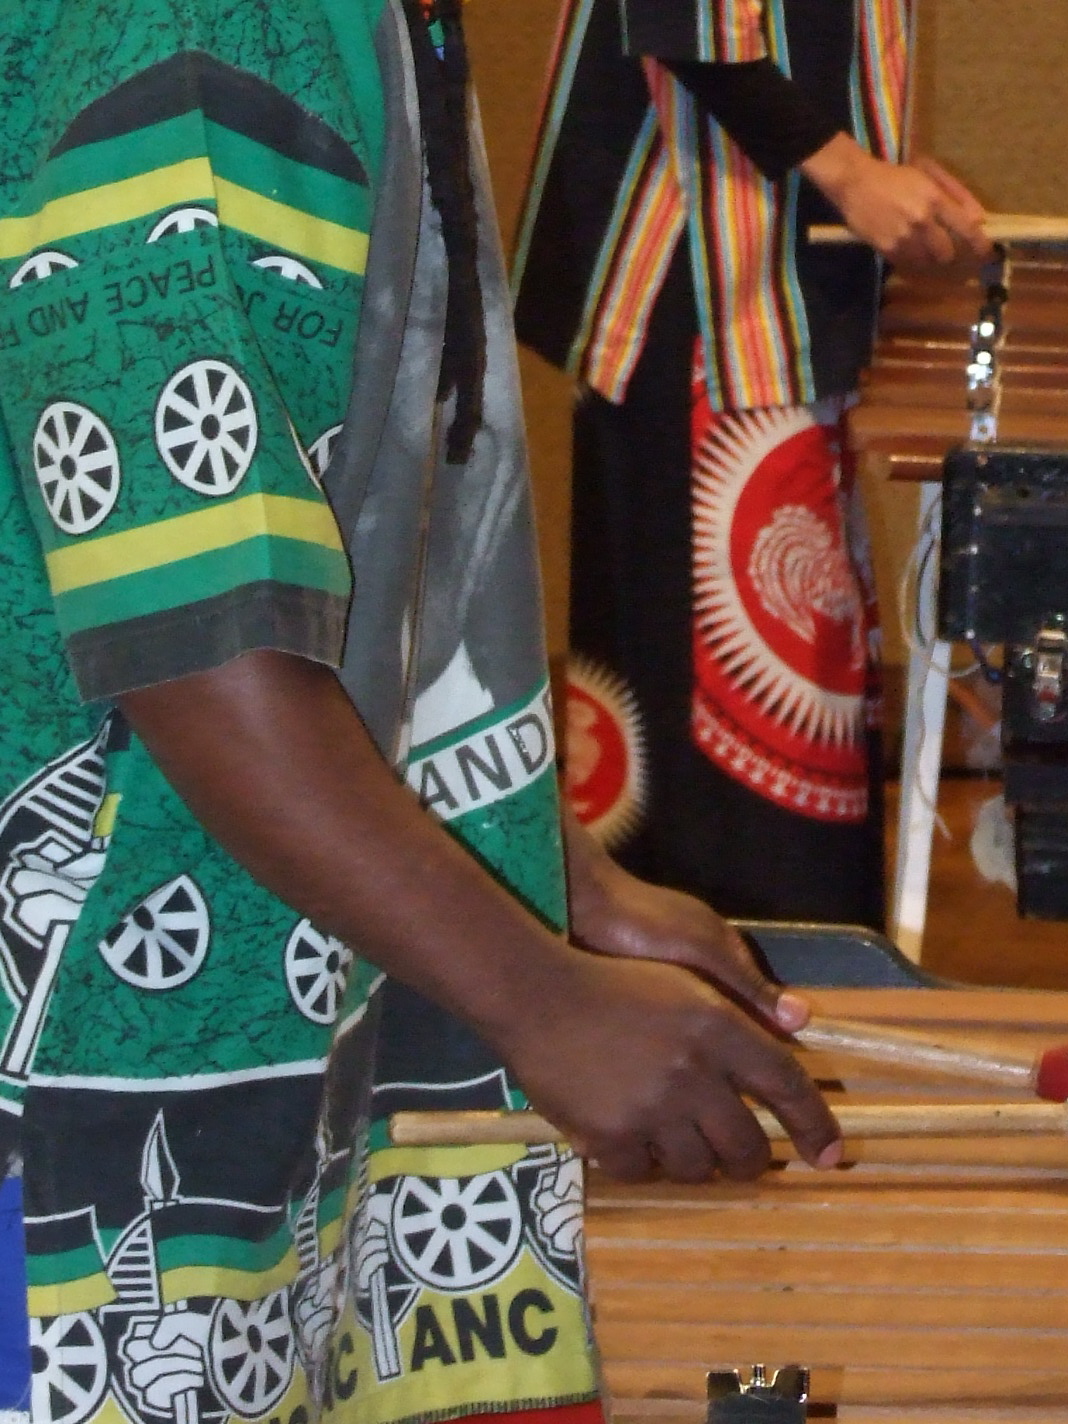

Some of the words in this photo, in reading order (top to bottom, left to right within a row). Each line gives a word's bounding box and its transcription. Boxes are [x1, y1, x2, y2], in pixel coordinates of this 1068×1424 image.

[28, 291, 89, 337] AND
[103, 254, 216, 315] PEACE
[273, 301, 344, 347] FOR
[418, 712, 546, 812] AND
[410, 1289, 558, 1372] ANC
